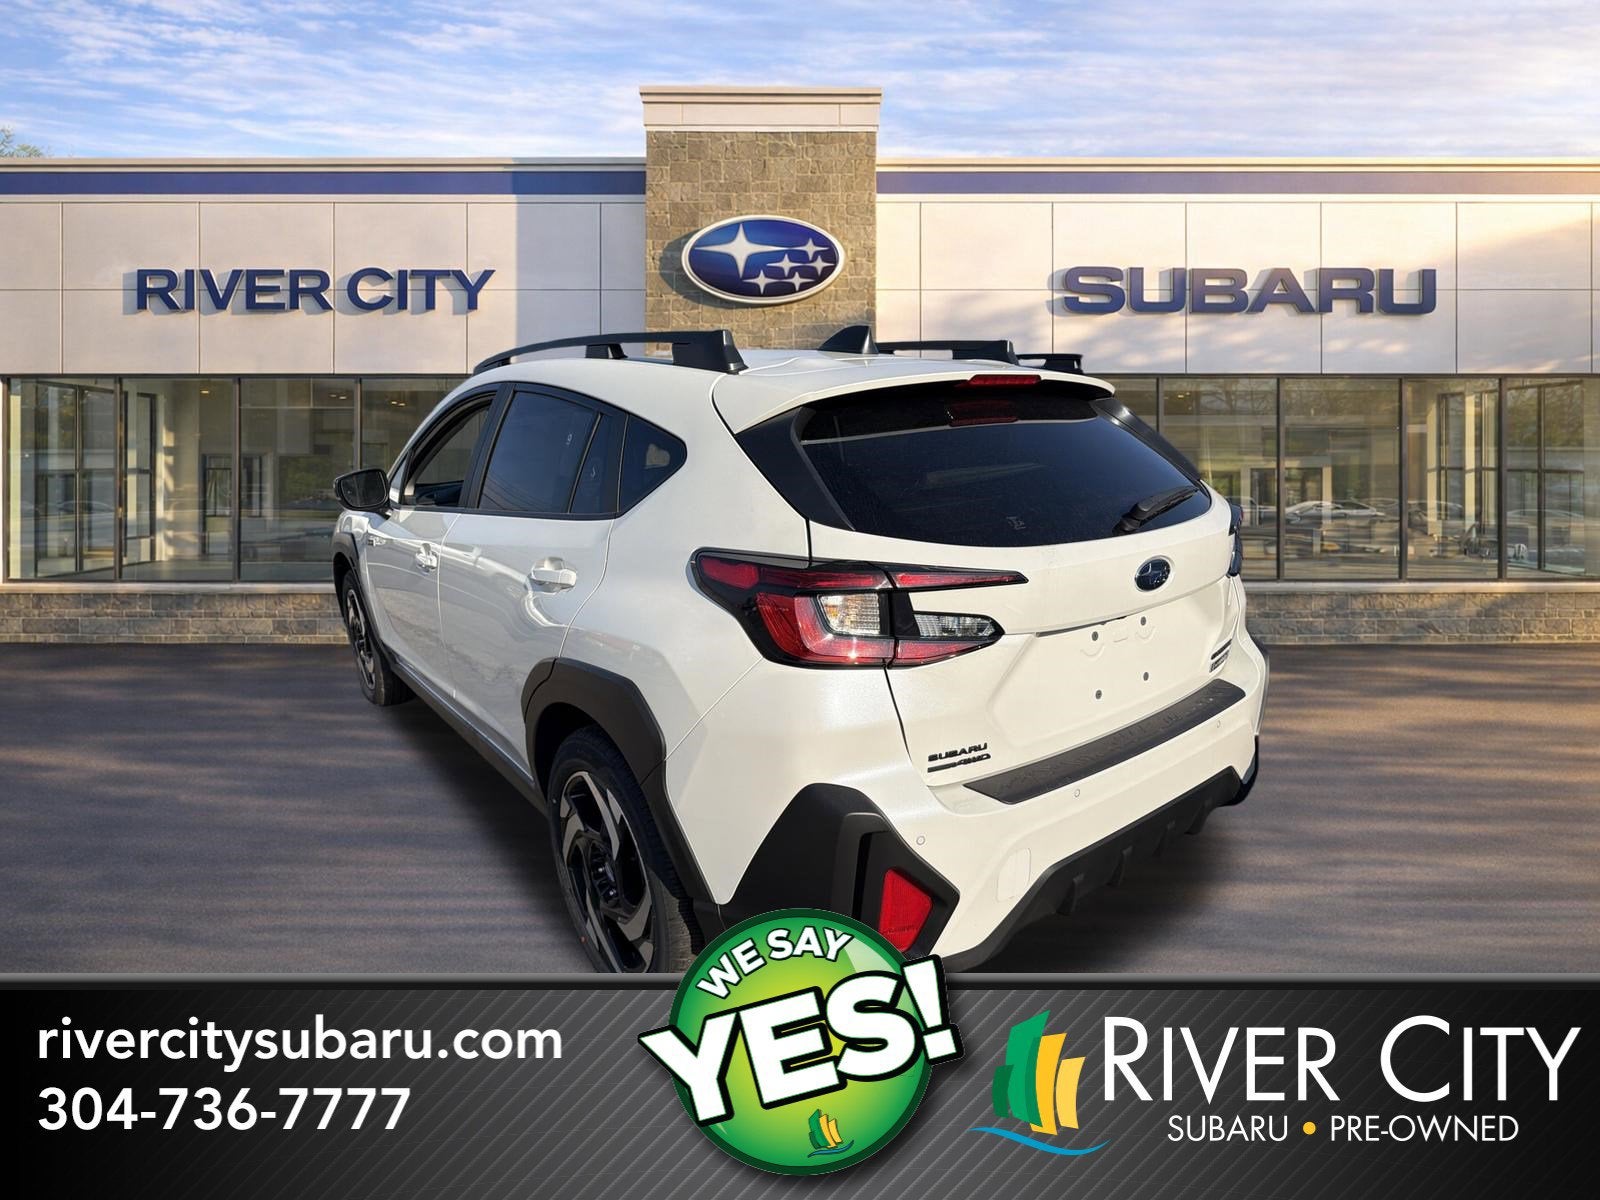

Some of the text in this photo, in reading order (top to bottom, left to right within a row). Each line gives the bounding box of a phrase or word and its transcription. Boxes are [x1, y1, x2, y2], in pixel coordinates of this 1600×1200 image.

[136, 267, 496, 311] RIVER CITY
[1064, 266, 1437, 314] SUBARU
[928, 742, 988, 762] SUBARU
